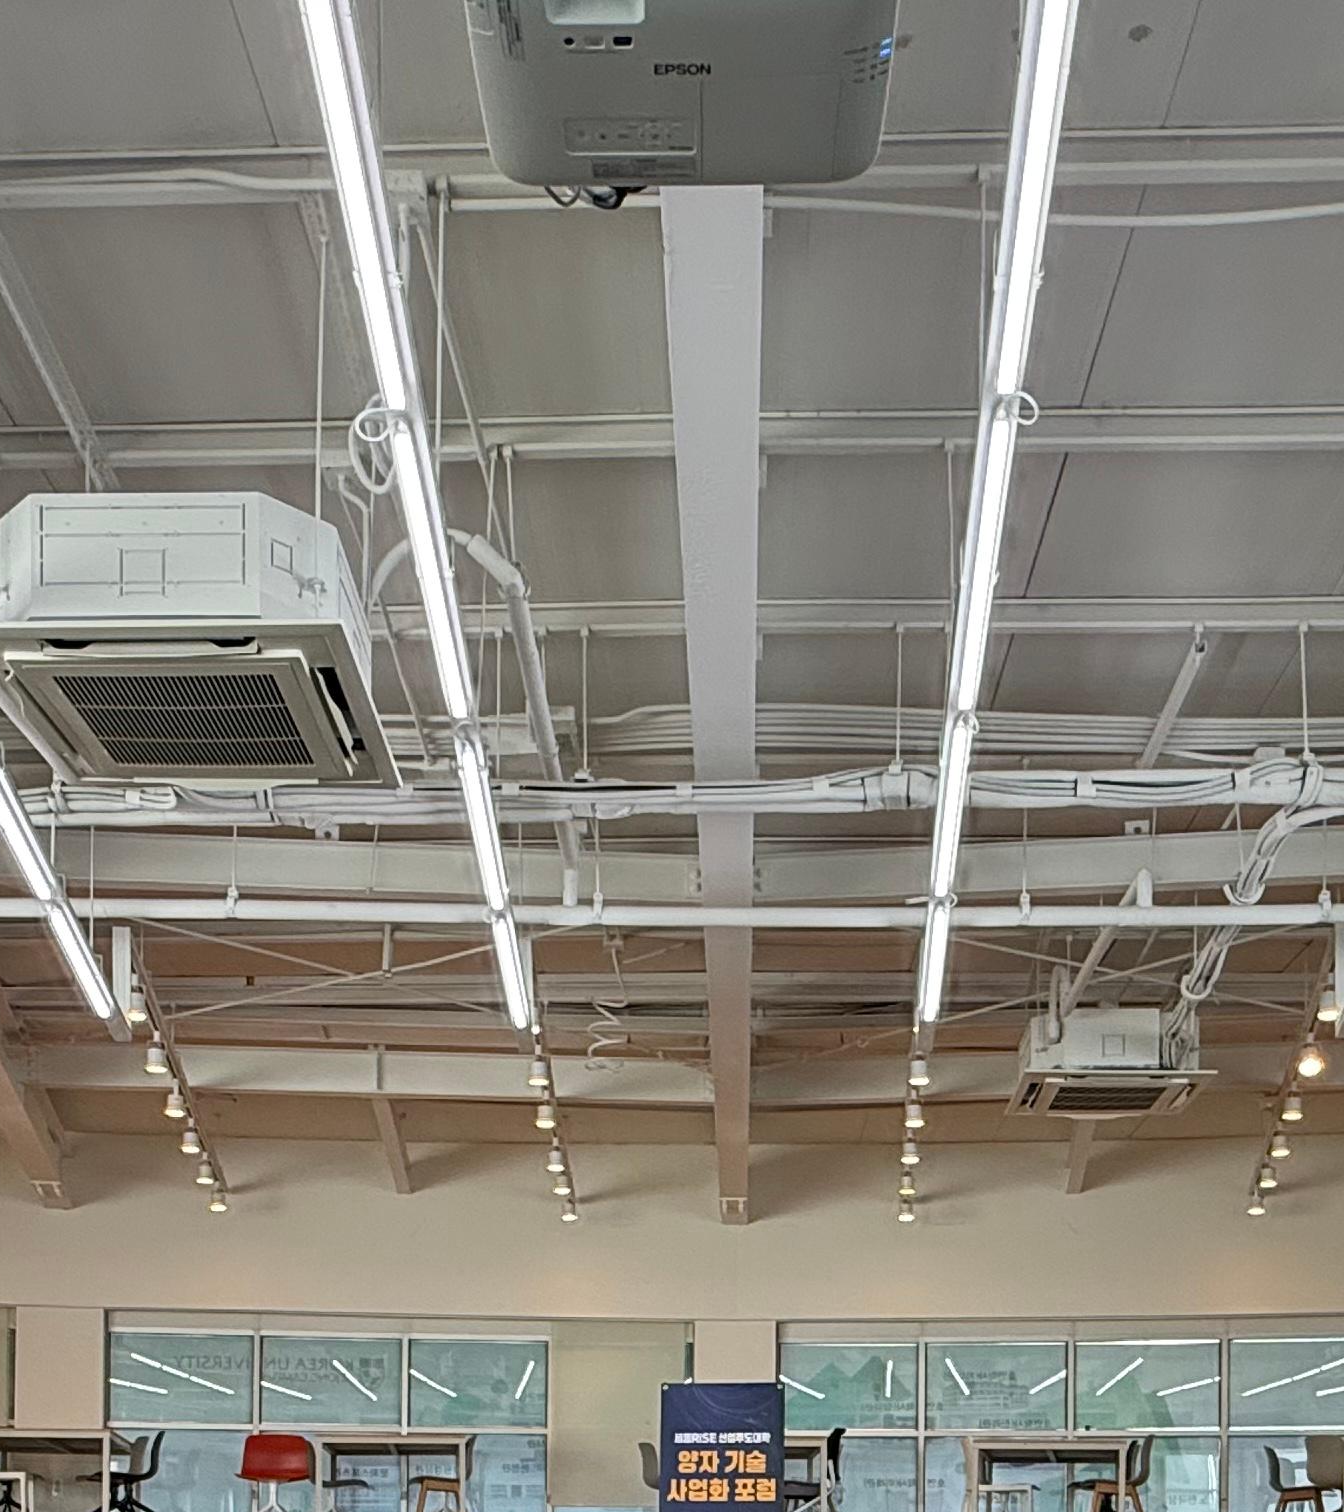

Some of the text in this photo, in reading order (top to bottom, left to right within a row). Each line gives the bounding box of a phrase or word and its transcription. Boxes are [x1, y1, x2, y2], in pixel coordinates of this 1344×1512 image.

[654, 64, 711, 75] EPSON
[678, 1450, 766, 1473] 양자 기술
[667, 1477, 776, 1502] 사업화 포럼
